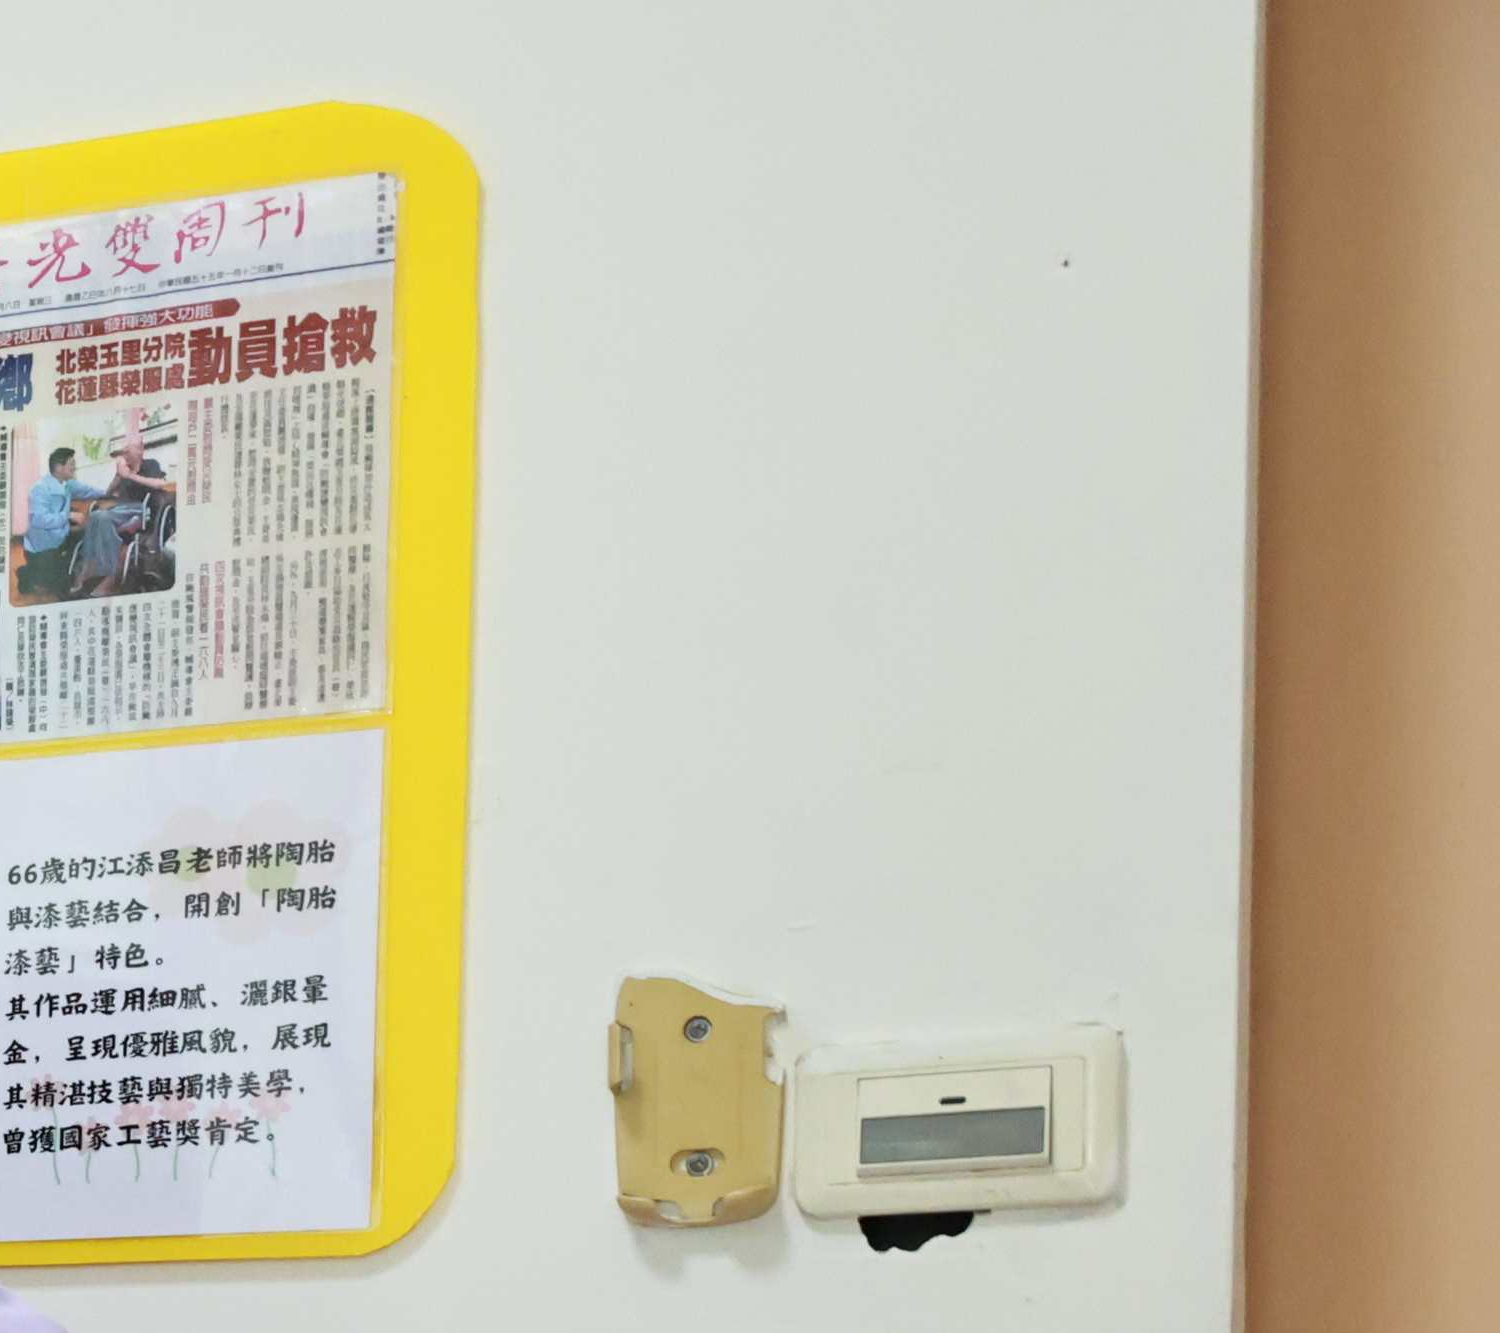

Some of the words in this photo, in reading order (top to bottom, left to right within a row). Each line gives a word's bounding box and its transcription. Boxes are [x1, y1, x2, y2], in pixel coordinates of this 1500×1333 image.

[55, 331, 187, 375] 北榮玉里分院
[186, 304, 378, 387] 動員搶救
[7, 839, 336, 886] 66歲的江添昌老師將陶胎
[3, 1116, 275, 1155] 曾獲國家工藝獎肯定。
